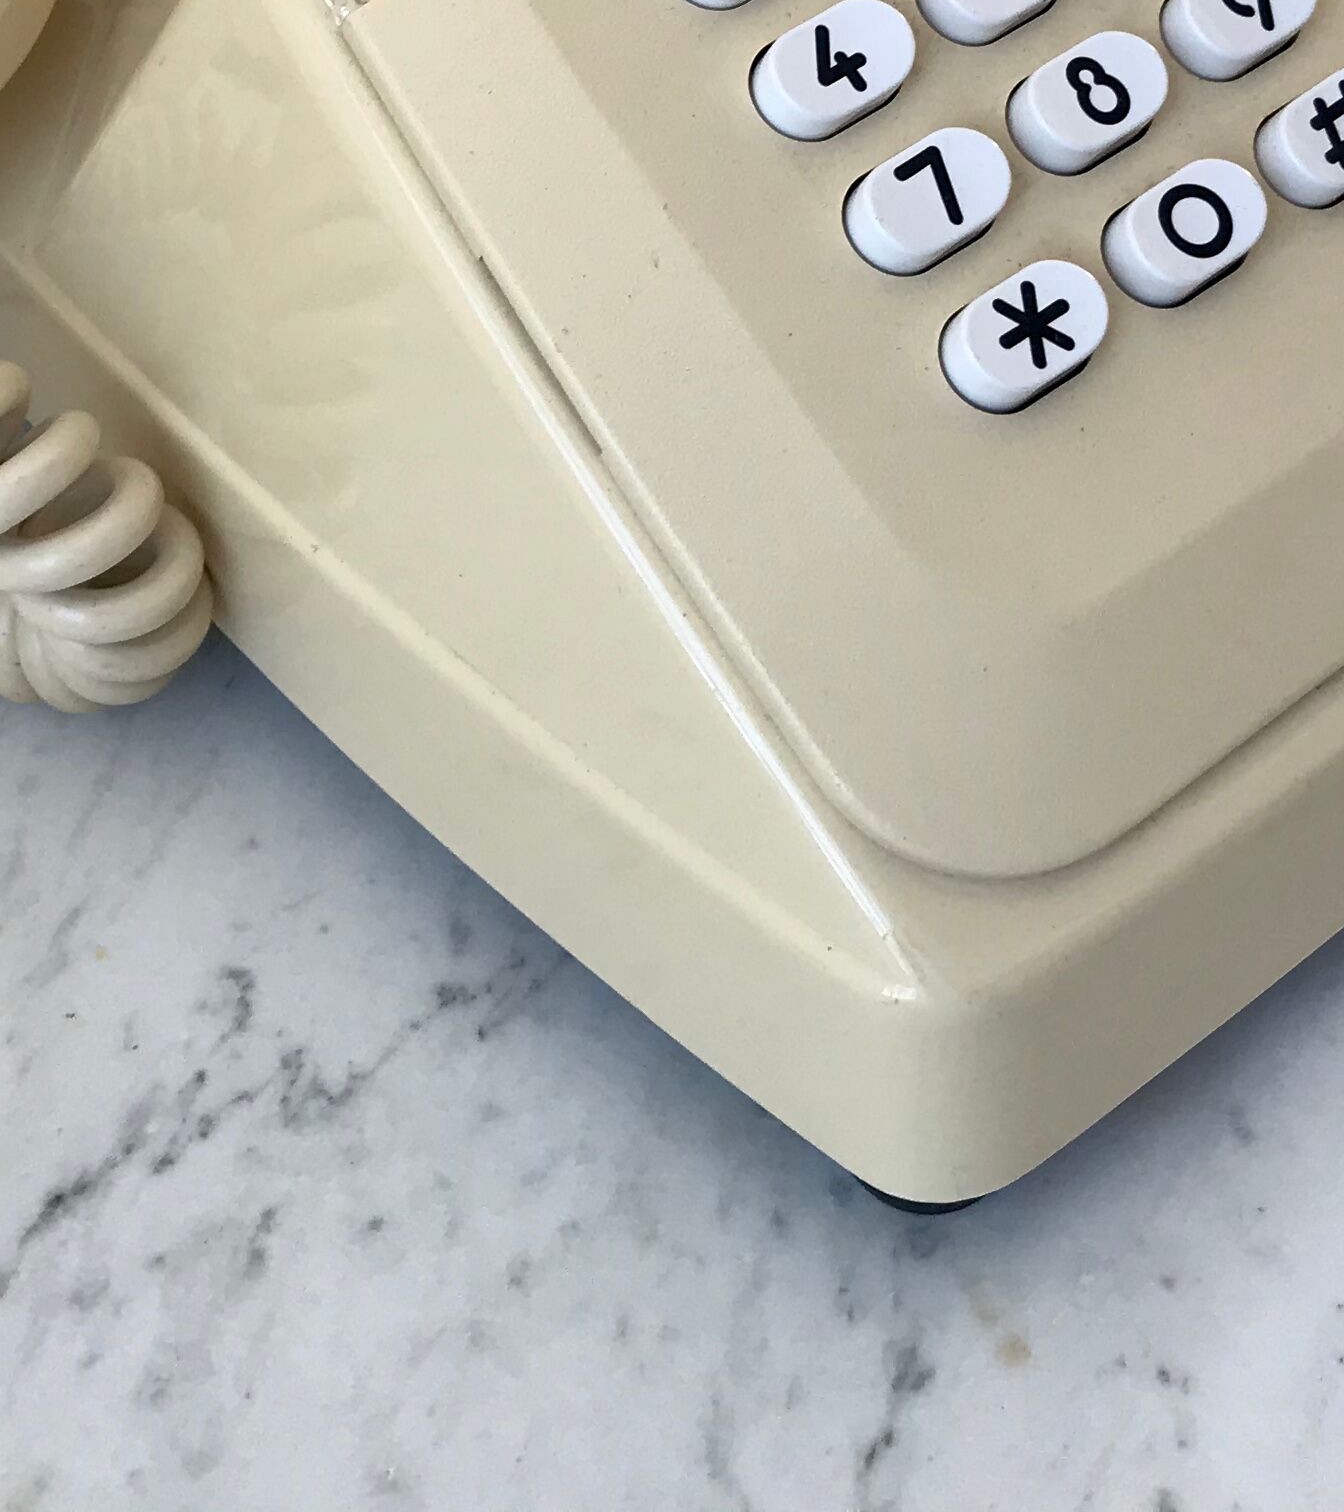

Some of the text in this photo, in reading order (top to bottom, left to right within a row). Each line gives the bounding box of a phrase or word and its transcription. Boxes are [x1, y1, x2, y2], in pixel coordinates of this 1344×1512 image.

[814, 24, 868, 92] 4
[893, 145, 964, 226] 7
[1065, 56, 1131, 126] 8
